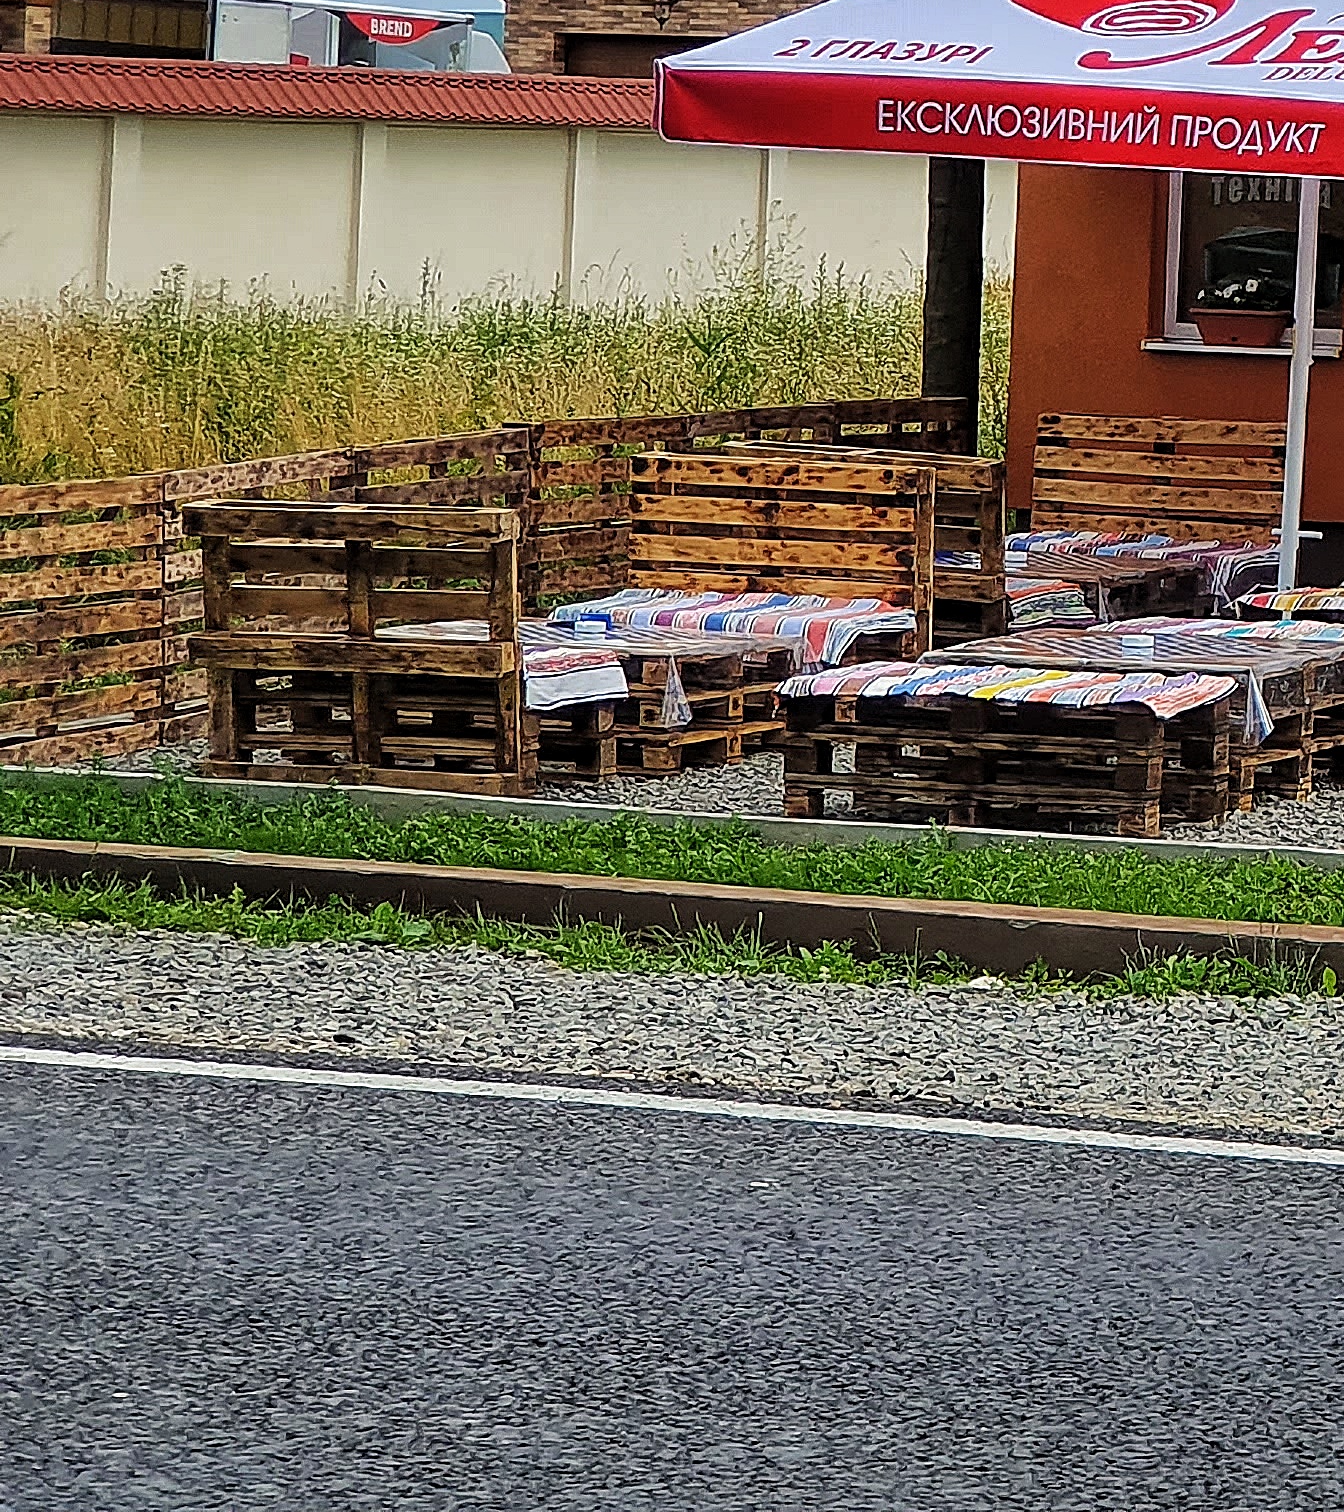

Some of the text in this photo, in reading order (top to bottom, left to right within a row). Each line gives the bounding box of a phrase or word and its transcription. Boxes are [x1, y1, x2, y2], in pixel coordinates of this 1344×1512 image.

[370, 18, 413, 38] BREND
[773, 38, 993, 65] 2 ГЛАЗУРІ
[876, 98, 1326, 156] ЕКСКЛЮЗИВНИЙ ПРОДУКТ
[1211, 175, 1332, 210] техніа
